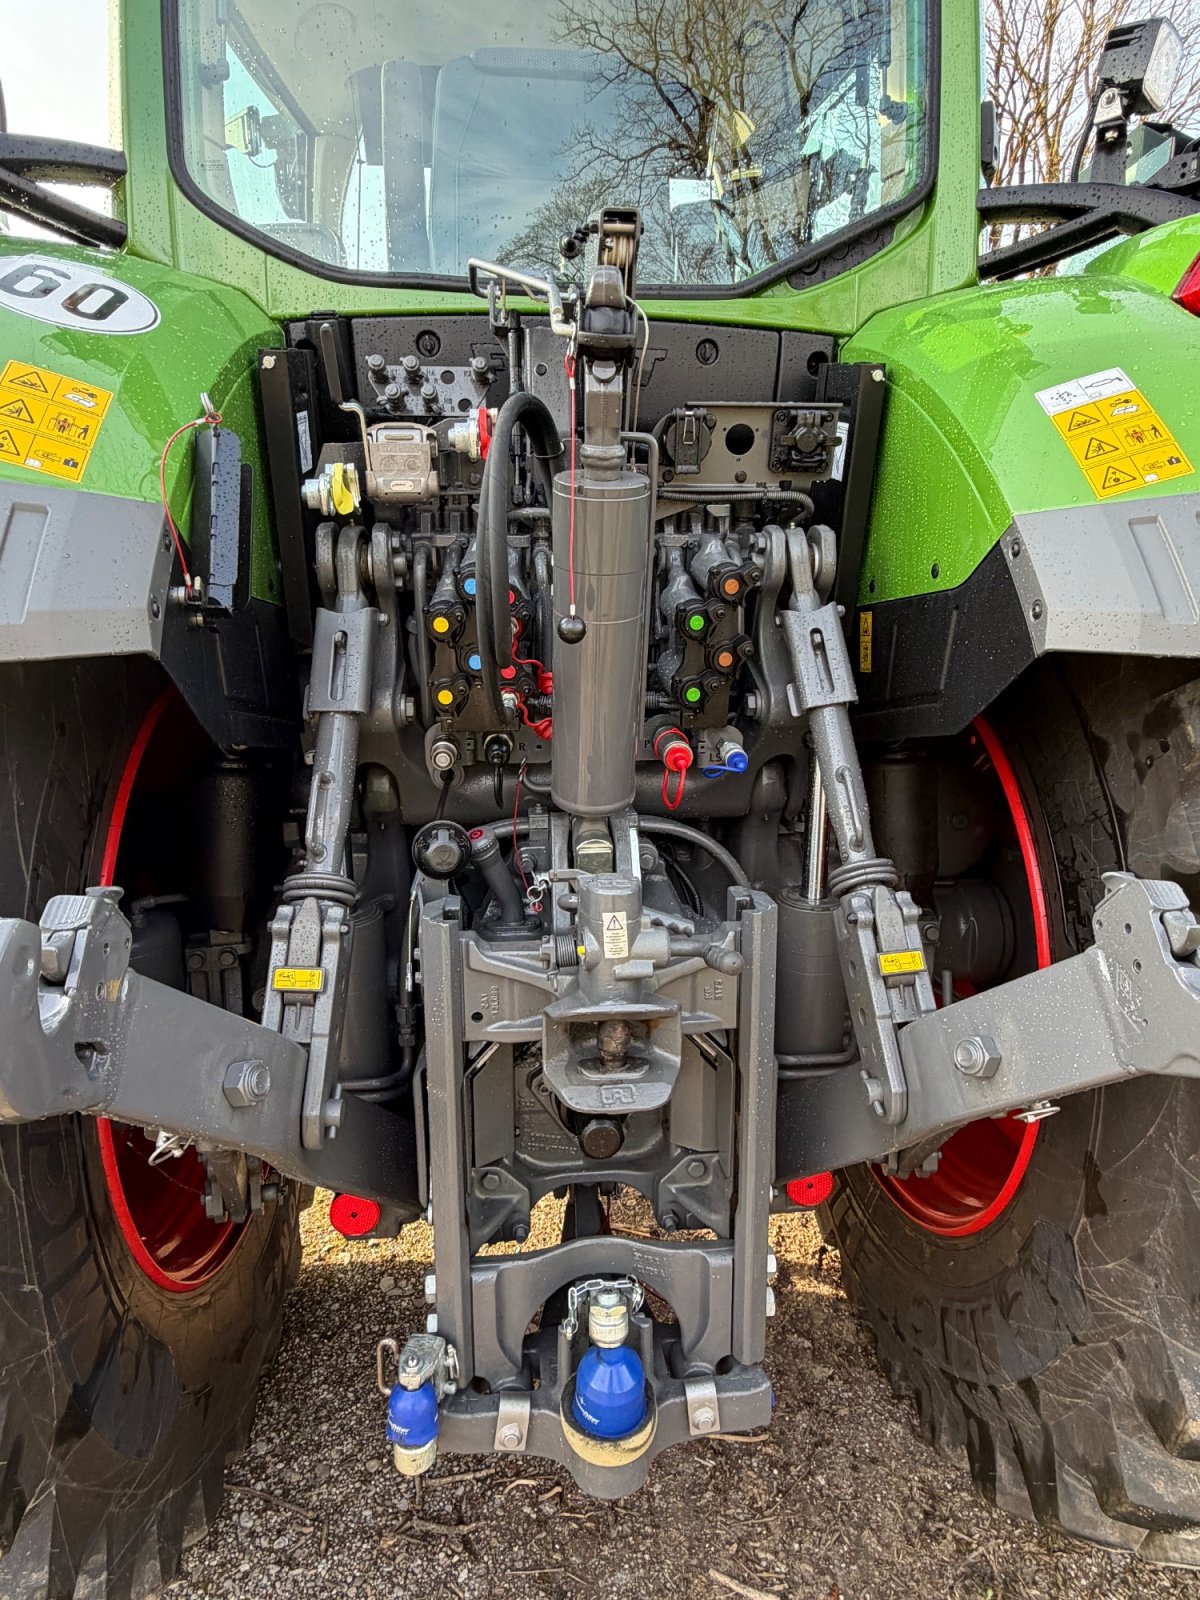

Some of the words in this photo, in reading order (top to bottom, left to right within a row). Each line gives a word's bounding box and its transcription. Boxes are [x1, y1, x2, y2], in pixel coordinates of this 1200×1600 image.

[0, 264, 129, 321] 60
[519, 743, 526, 751] R
[645, 740, 651, 749] P
[710, 753, 722, 762] LS
